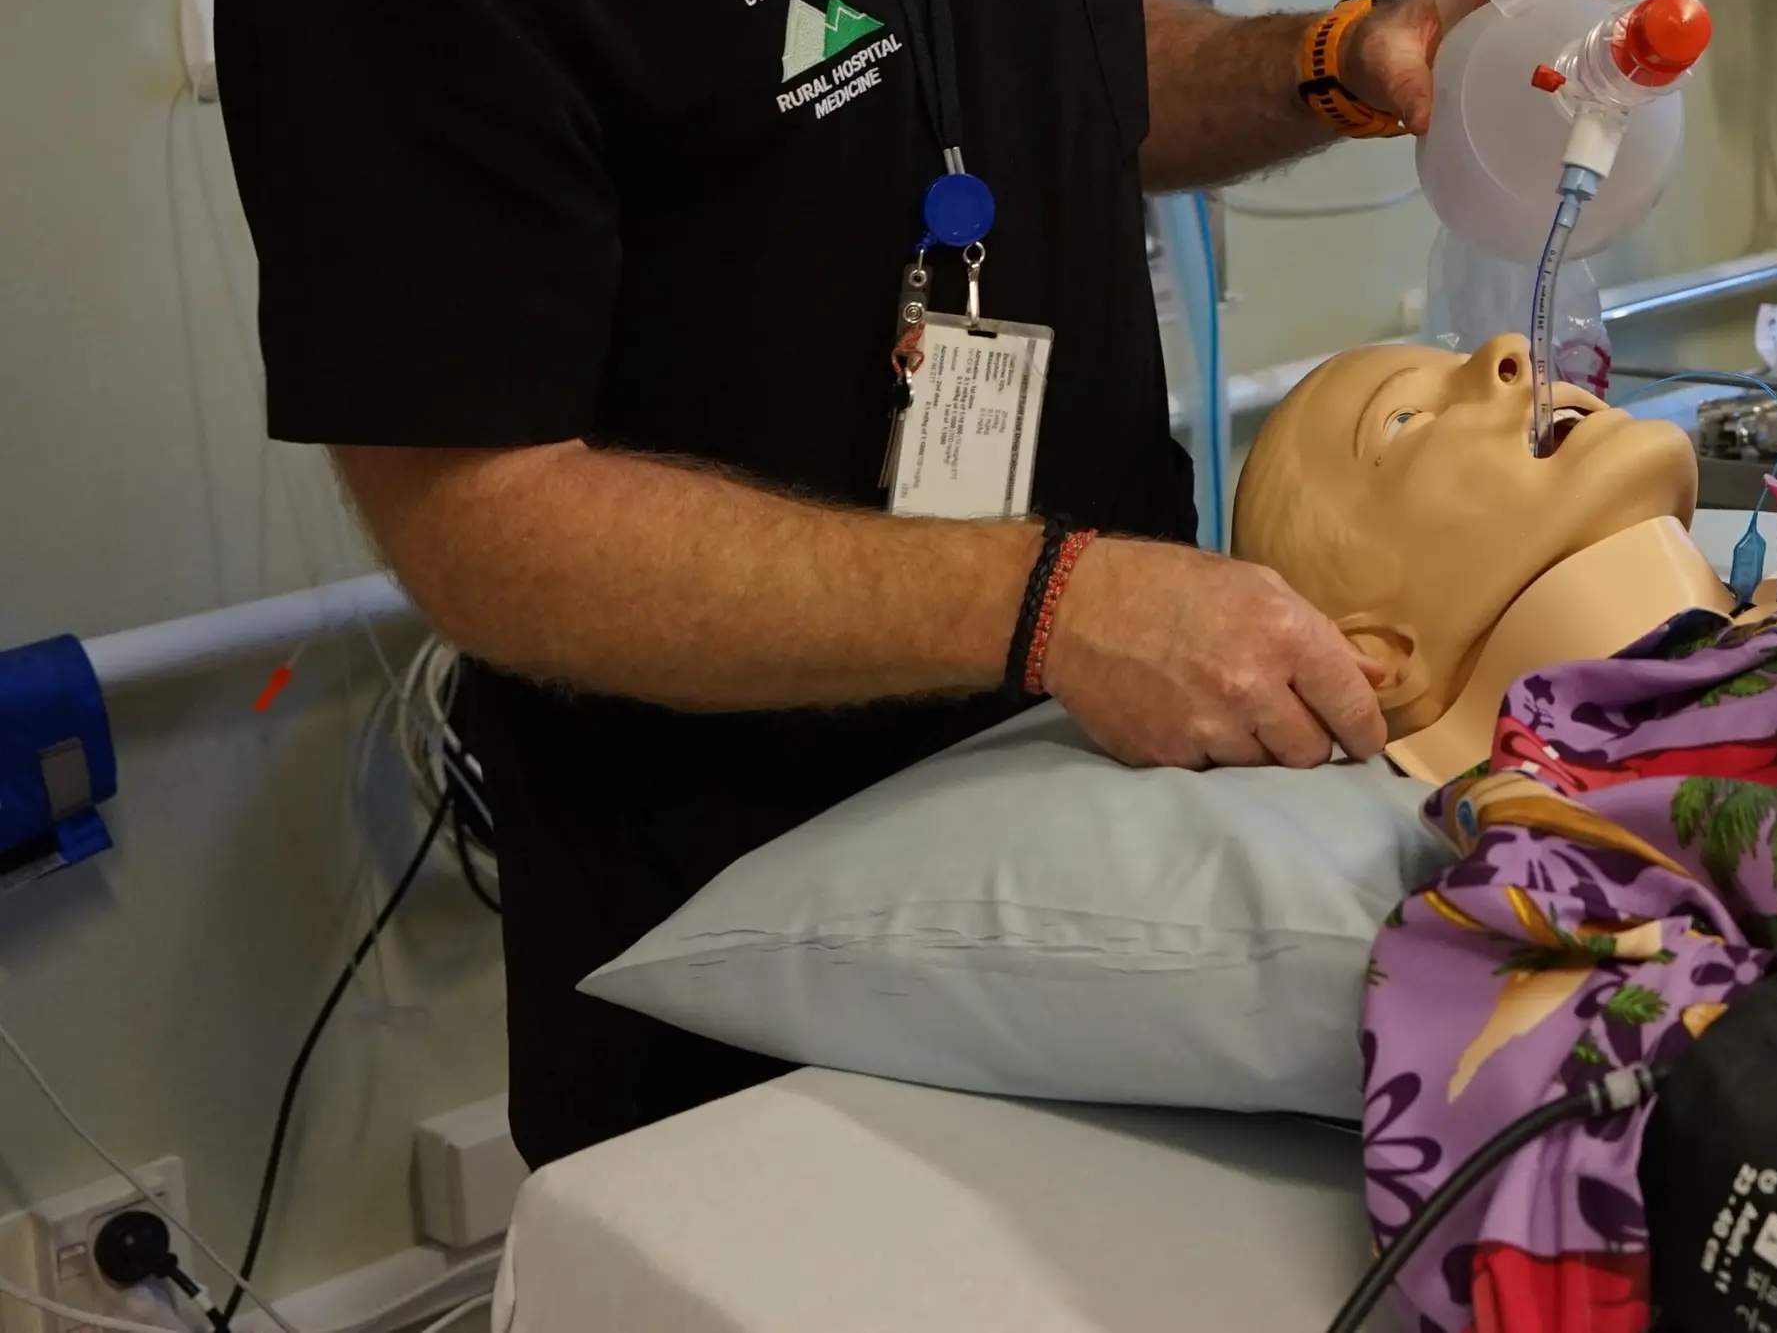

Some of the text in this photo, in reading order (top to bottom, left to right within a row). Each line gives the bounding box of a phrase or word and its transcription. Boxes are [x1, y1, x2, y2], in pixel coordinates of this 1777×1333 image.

[775, 33, 903, 113] RURAL HOSPITAL
[813, 66, 882, 120] MEDICINE
[1732, 1162, 1758, 1197] 23
[1712, 1207, 1734, 1239] 40
[1725, 1200, 1759, 1257] Adult
